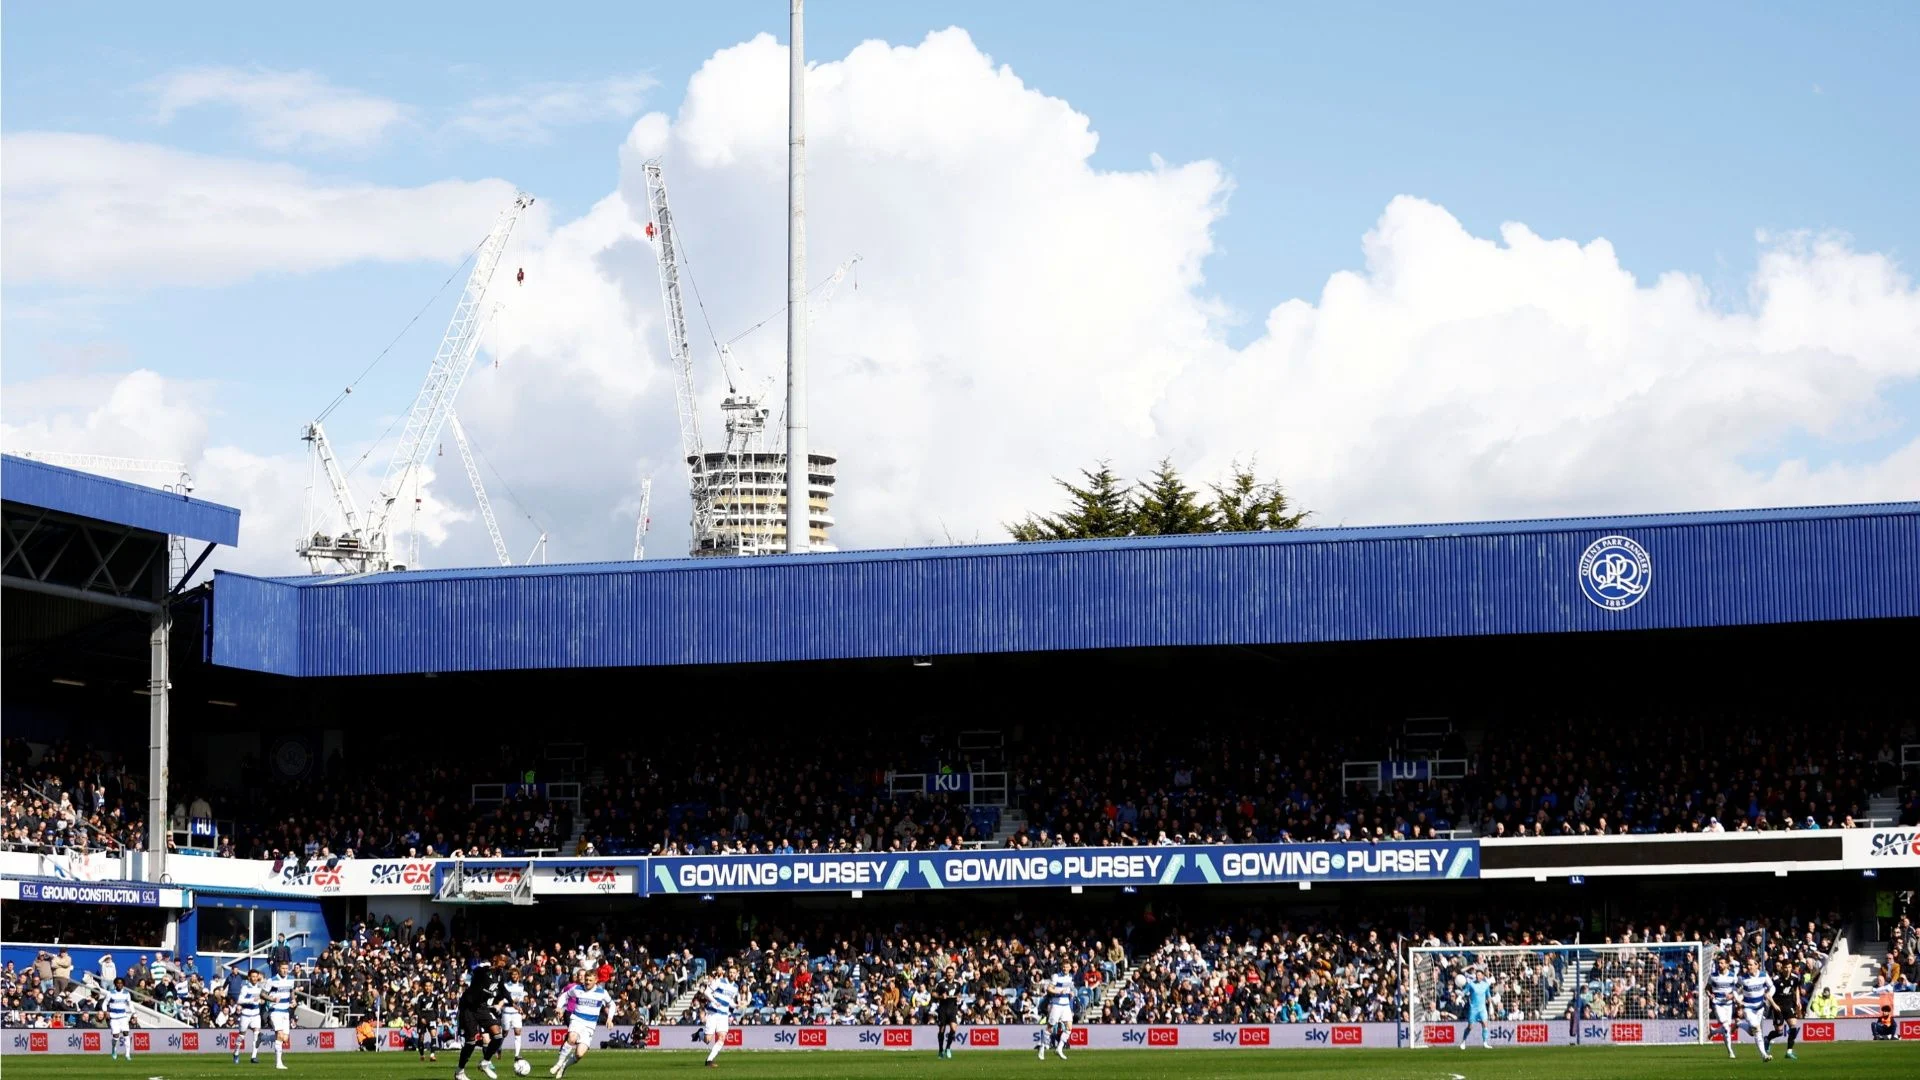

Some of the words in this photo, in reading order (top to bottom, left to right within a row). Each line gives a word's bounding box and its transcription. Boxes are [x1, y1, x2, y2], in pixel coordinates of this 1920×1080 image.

[1582, 544, 1601, 576] QUEENS
[1602, 539, 1622, 548] PARK
[1624, 541, 1648, 573] RANGERS
[1392, 762, 1417, 779] LU
[935, 774, 961, 791] KU
[197, 818, 211, 835] HU
[945, 858, 1047, 882] GOWING
[1064, 855, 1162, 879] PURSEY
[1223, 851, 1330, 876] GOWING
[1347, 848, 1449, 873] PURSEY
[680, 864, 778, 887] GOWING
[794, 861, 887, 884] PURSEY
[22, 884, 39, 896] GCL
[42, 885, 77, 901] GROUND
[78, 888, 140, 904] CONSTRUCTION
[142, 891, 157, 902] GCL
[528, 1029, 549, 1045] sky
[726, 1031, 740, 1043] et
[774, 1029, 797, 1045] sky
[801, 1030, 824, 1043] bet
[859, 1029, 882, 1045] sky
[886, 1030, 909, 1043] bet
[973, 1030, 997, 1042] bet
[1070, 1030, 1085, 1042] et
[1122, 1028, 1146, 1045] sky
[1151, 1029, 1175, 1042] bet
[1213, 1028, 1237, 1044] sky
[1242, 1029, 1266, 1042] bet
[1305, 1027, 1329, 1044] sky
[1334, 1028, 1359, 1041] bet
[1490, 1025, 1514, 1042] sky
[1519, 1026, 1546, 1039] bet
[1584, 1024, 1608, 1040] sky
[1614, 1025, 1640, 1039] bet
[1806, 1025, 1832, 1037] bet
[14, 1033, 29, 1048] sky
[31, 1034, 47, 1048] bet
[68, 1033, 82, 1048] sky
[84, 1034, 99, 1048] bet
[135, 1034, 149, 1047] bet
[168, 1034, 183, 1048] sky
[183, 1034, 197, 1048] bet
[216, 1033, 229, 1048] sky
[306, 1033, 319, 1048] sky
[320, 1034, 334, 1046] bet
